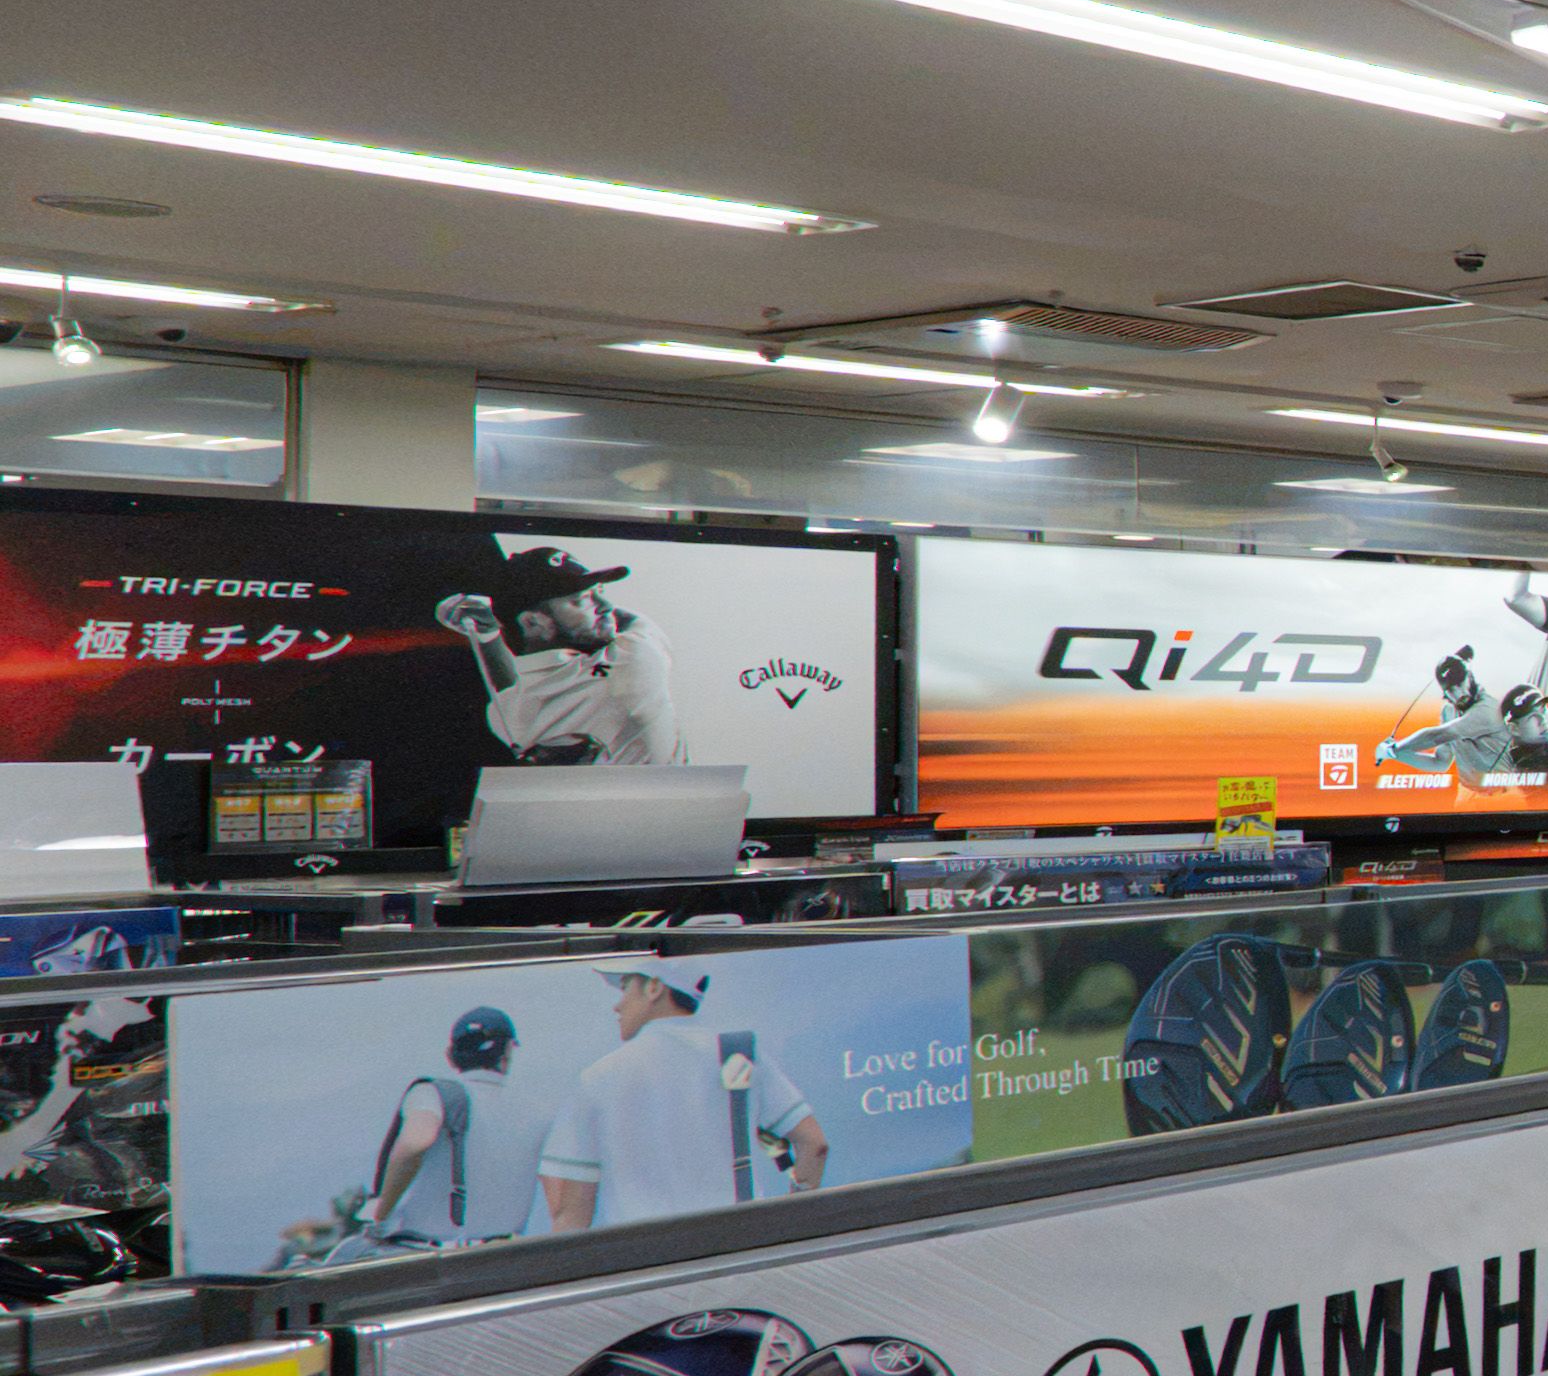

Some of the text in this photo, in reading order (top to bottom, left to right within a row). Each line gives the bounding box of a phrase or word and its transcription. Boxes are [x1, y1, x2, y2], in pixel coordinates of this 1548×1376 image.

[119, 575, 315, 599] TRI-FORCE
[74, 618, 353, 662] 極薄チタン
[738, 657, 843, 692] Callaway
[108, 735, 326, 775] カーボン
[1323, 748, 1355, 760] TEAM
[1378, 774, 1452, 789] FLEETWOOD
[1482, 772, 1547, 787] MORIKAWA
[904, 882, 1101, 913] 買取マイスターとは
[843, 1031, 1047, 1081] Love for Golf,
[861, 1050, 1160, 1116] Crafted Through Time
